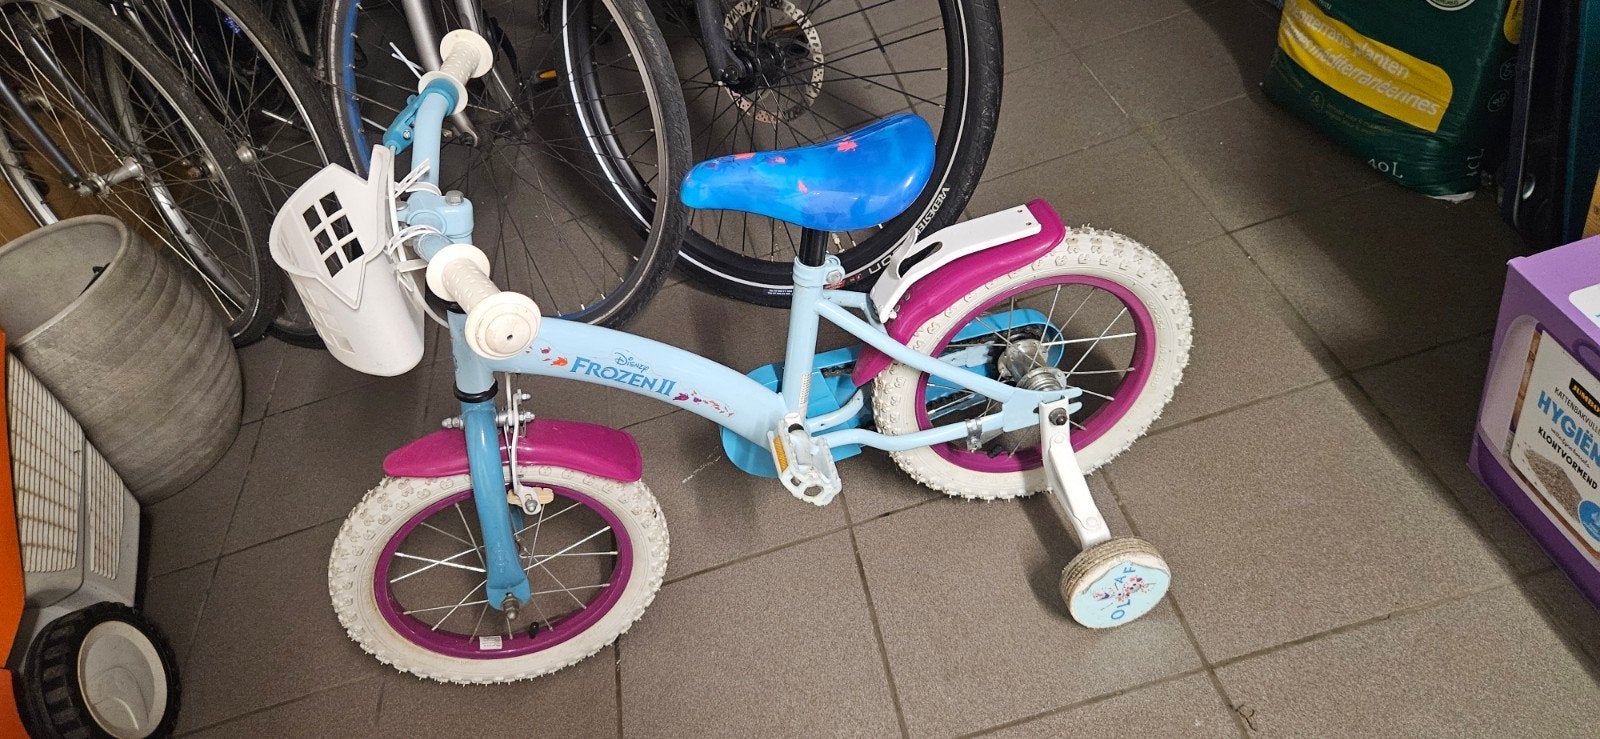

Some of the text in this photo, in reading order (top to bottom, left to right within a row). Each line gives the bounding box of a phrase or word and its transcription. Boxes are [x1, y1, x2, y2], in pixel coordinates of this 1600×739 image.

[1353, 42, 1409, 79] planten
[916, 187, 950, 235] VREDESTE
[569, 356, 677, 396] FROZEN II
[1538, 426, 1598, 490] KLONTVORMEND
